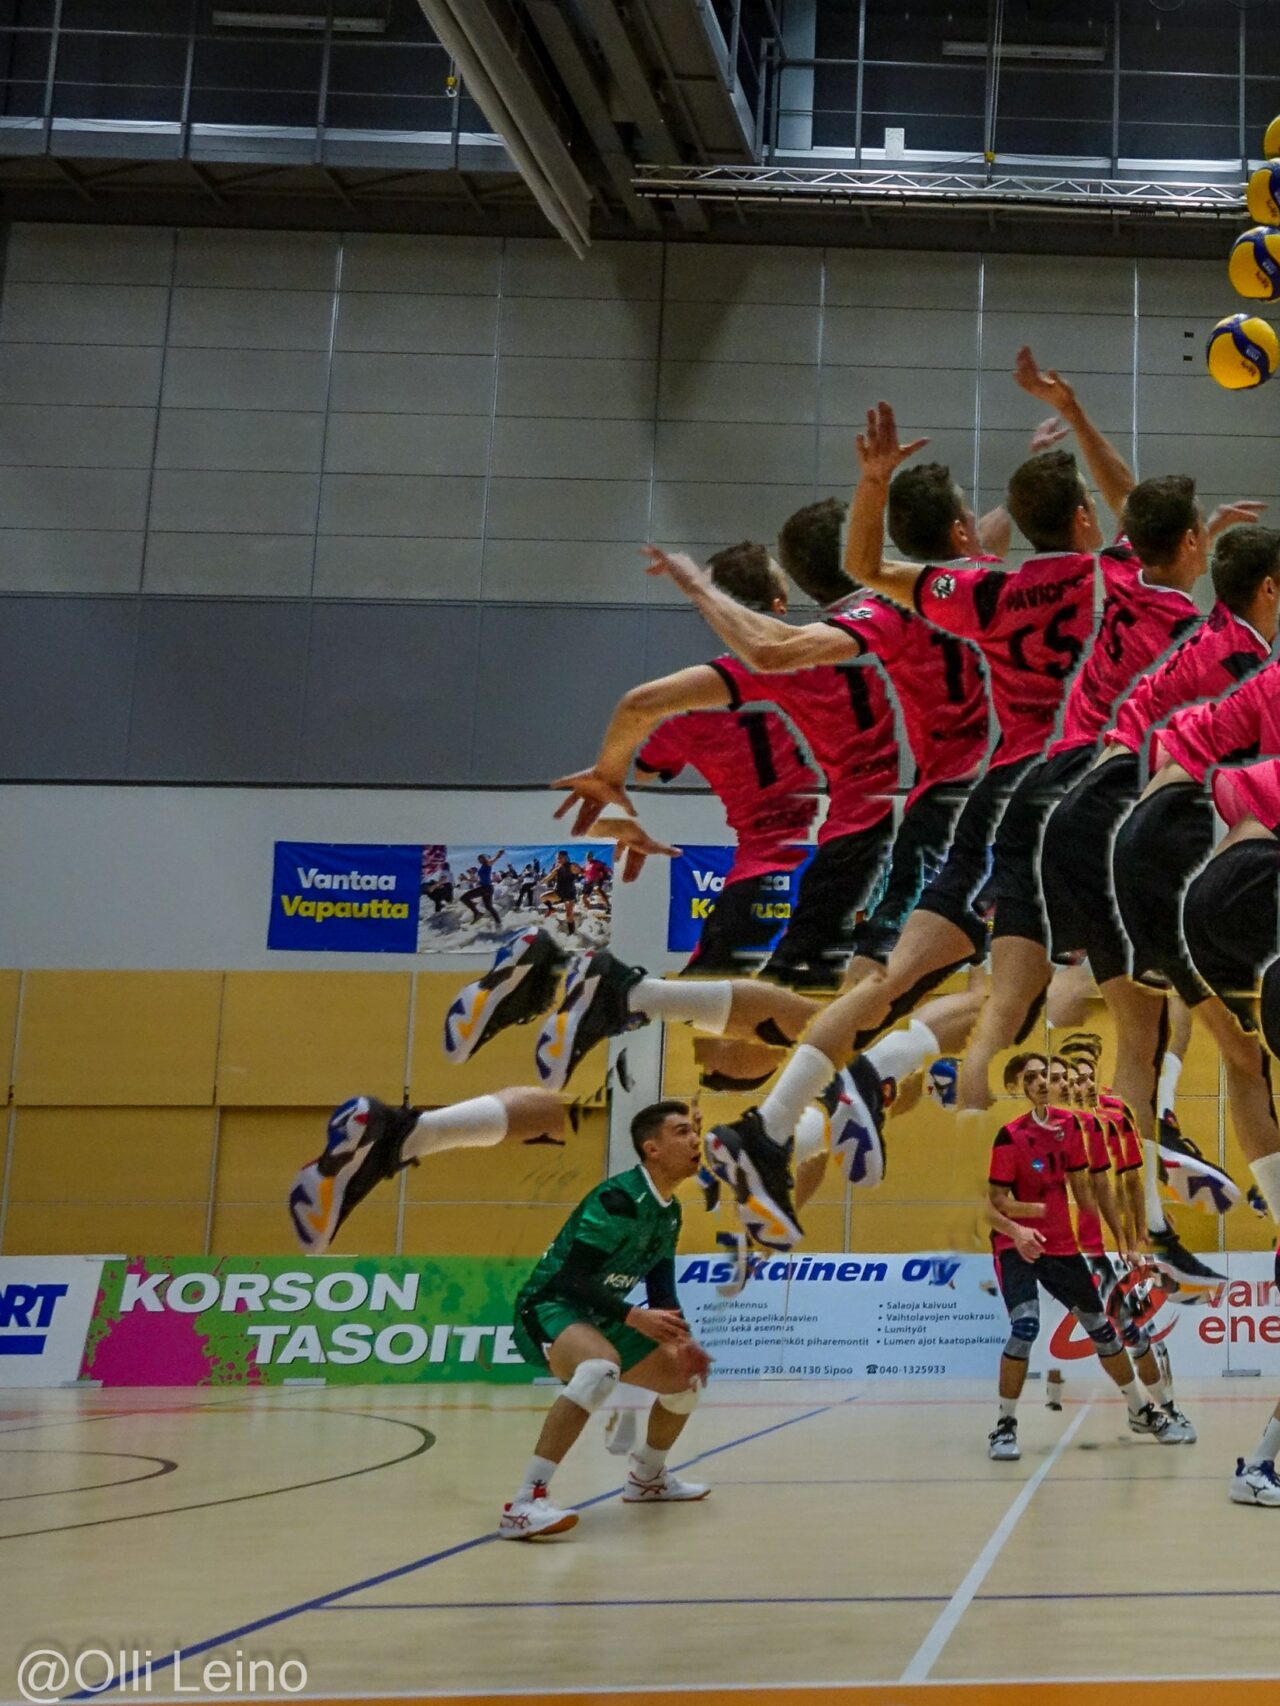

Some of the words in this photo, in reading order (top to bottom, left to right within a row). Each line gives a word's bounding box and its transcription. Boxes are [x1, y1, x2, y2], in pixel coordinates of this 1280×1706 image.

[930, 632, 965, 703] 1
[835, 666, 875, 731] 1
[739, 713, 779, 789] 1
[297, 867, 397, 891] Vantaa
[281, 895, 410, 923] Vapautta
[119, 1271, 421, 1313] KORSON
[0, 1284, 69, 1328] RT
[886, 1301, 920, 1312] Salaoja
[922, 1301, 958, 1310] kaivuut
[886, 1311, 950, 1323] Vaihtolavojen
[953, 1311, 995, 1321] vuokraus
[807, 1335, 870, 1348] piharemontit
[883, 1336, 915, 1346] Lumen
[918, 1336, 936, 1348] ajot
[884, 1325, 927, 1337] Lumityöt
[246, 1323, 526, 1365] TASOITE
[789, 1364, 821, 1375] 04130
[824, 1364, 853, 1376] Sipoo
[879, 1365, 946, 1375] 040-1325933
